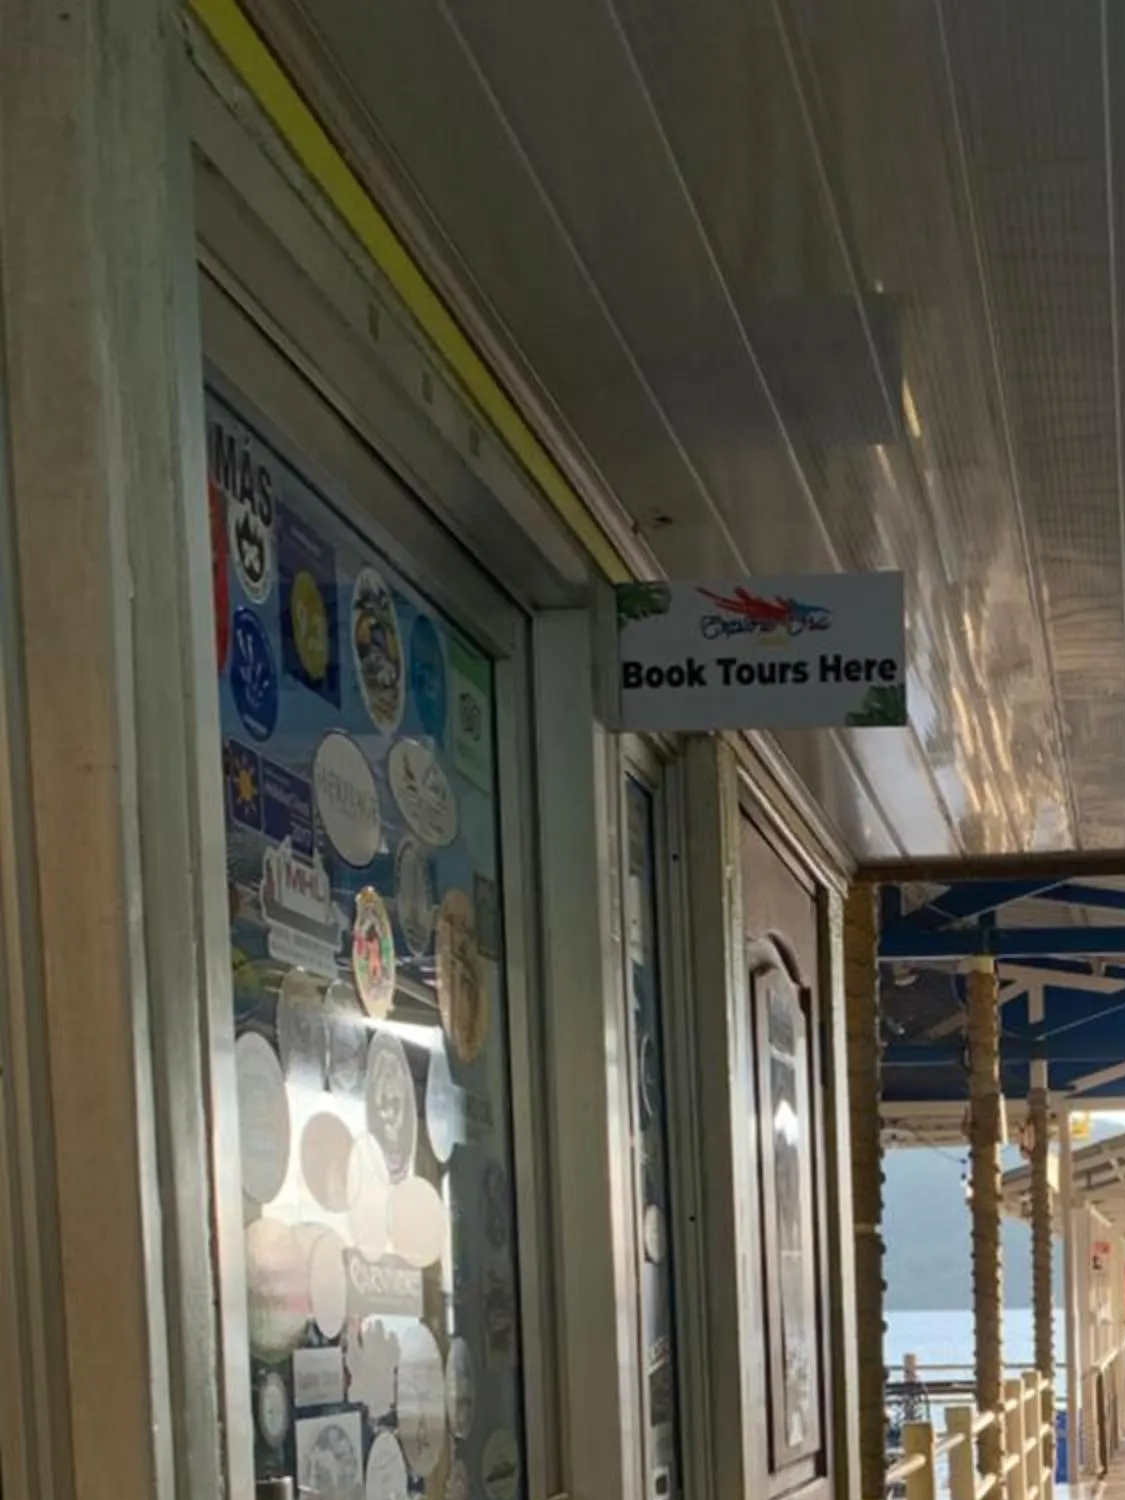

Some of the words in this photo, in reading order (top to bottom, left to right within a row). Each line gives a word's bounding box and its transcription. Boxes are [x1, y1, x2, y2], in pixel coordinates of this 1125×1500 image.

[622, 657, 707, 689] Book
[717, 656, 808, 686] Tours
[819, 653, 898, 682] Here
